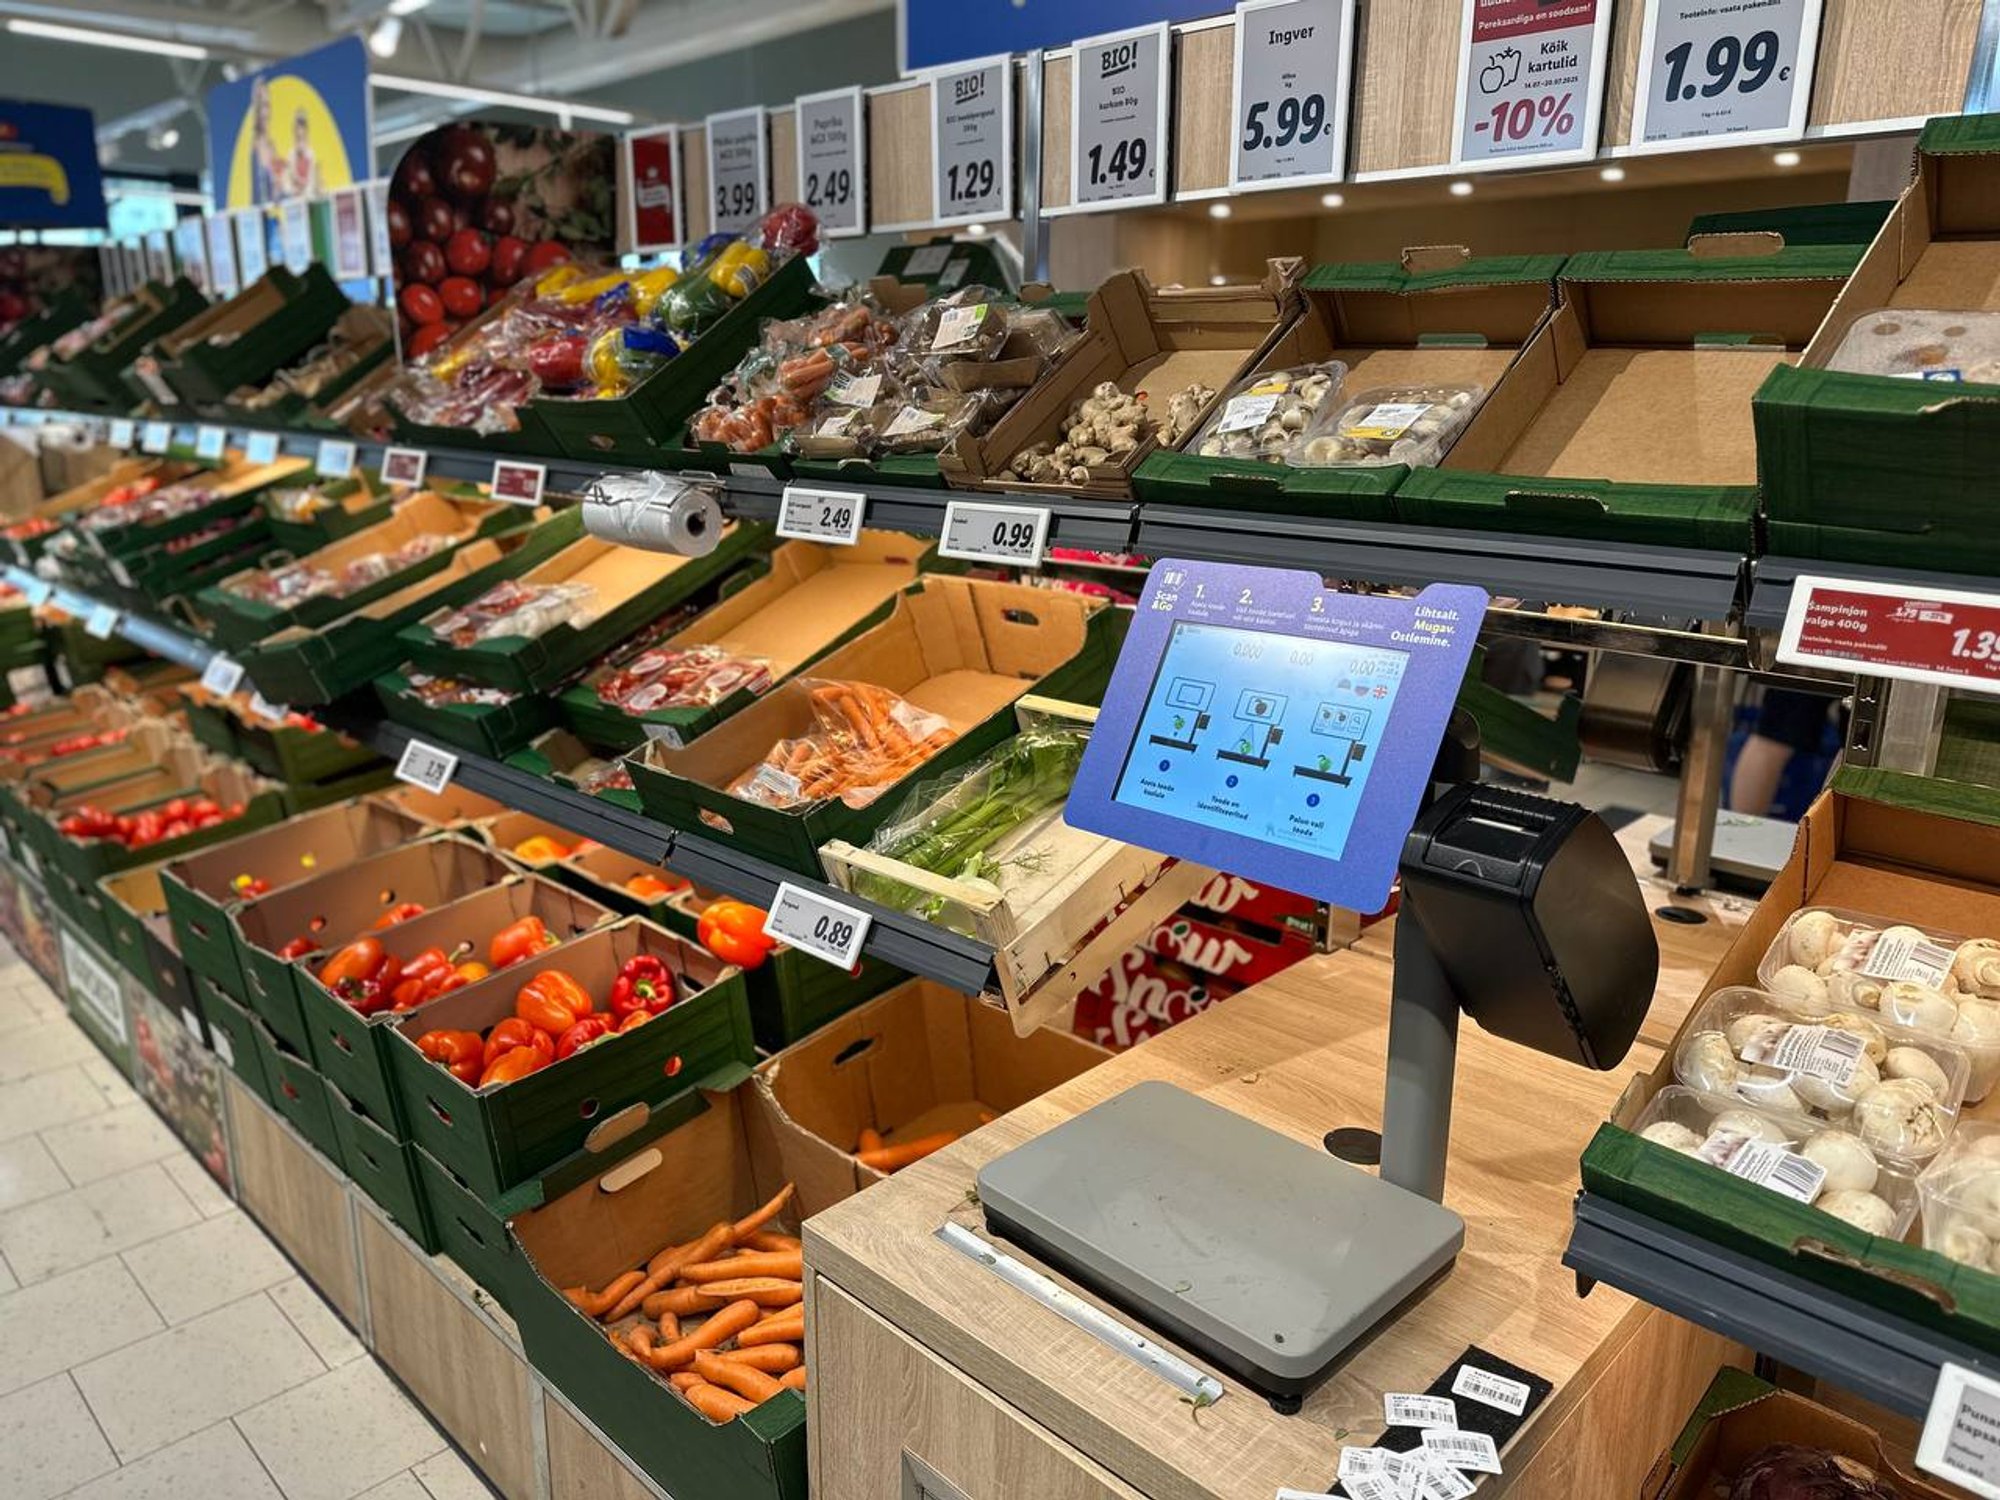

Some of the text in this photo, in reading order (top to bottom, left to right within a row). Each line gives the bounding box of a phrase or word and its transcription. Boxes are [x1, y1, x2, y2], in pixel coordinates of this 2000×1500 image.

[1268, 26, 1315, 46] Ingver
[1101, 41, 1139, 72] BIO!
[1527, 55, 1578, 74] kartulid
[1665, 30, 1779, 103] 1.99
[955, 72, 985, 99] BIO!
[1243, 94, 1326, 151] 5.99
[1474, 93, 1575, 143] -10%
[1089, 138, 1147, 185] 1.49
[807, 169, 851, 207] 2.49
[947, 160, 994, 201] 1.29
[717, 182, 756, 218] 3.99
[820, 506, 852, 529] 2.49
[992, 522, 1034, 548] 0.99
[1154, 590, 1179, 602] Scan
[1238, 589, 1253, 604] 2.
[1311, 597, 1326, 612] 3.
[1414, 606, 1460, 621] Lihtsalt.
[1805, 616, 1868, 633] valge 400g
[1390, 630, 1451, 648] Ostlemine.
[1413, 620, 1456, 634] Mugav.
[814, 915, 853, 948] 0.89
